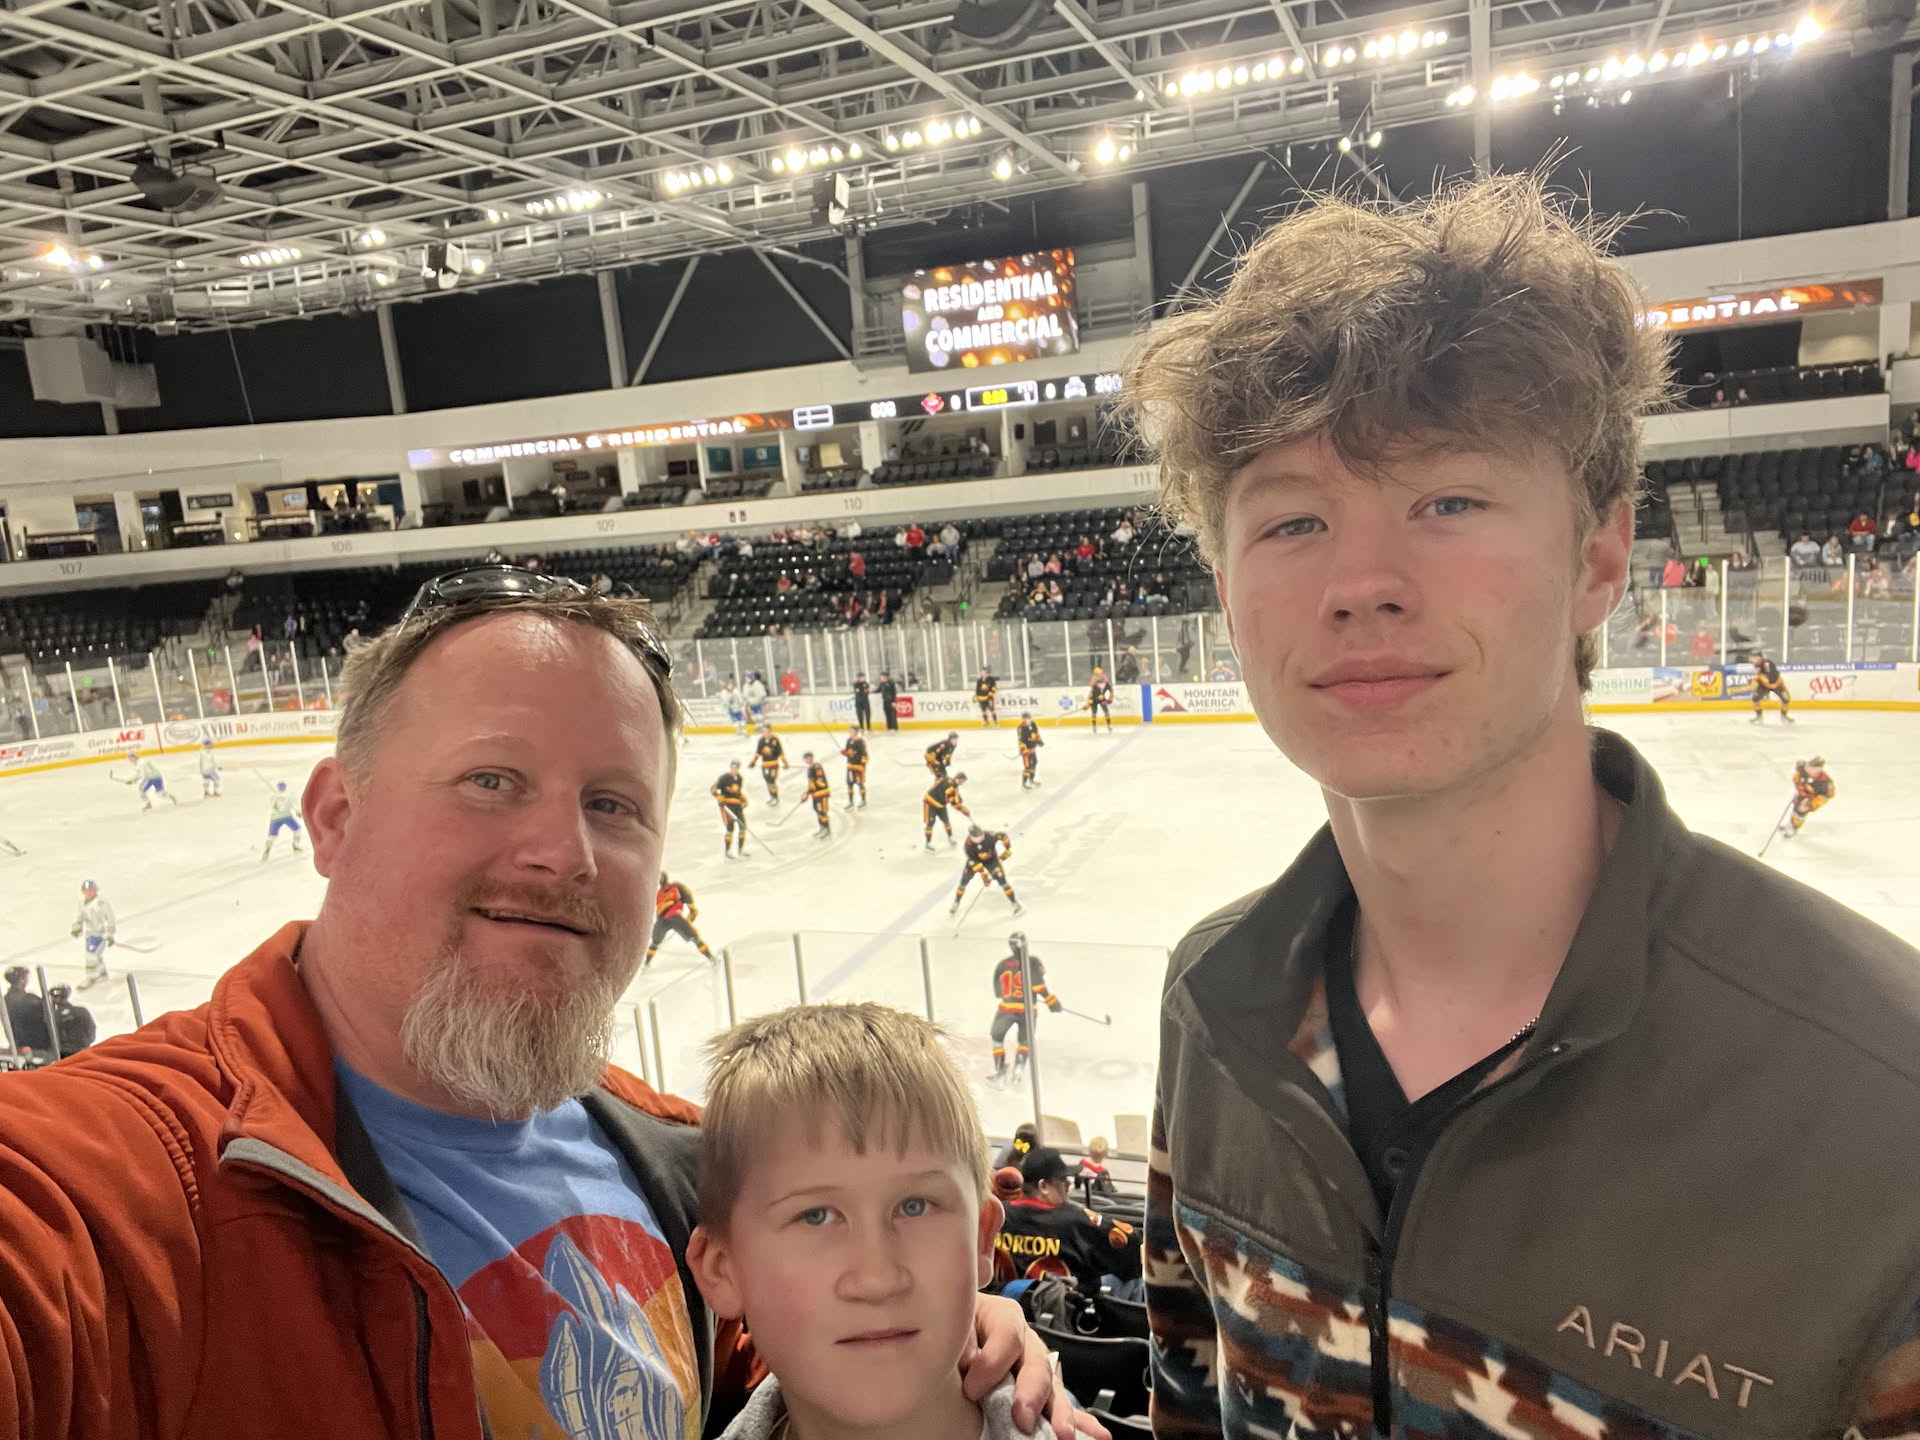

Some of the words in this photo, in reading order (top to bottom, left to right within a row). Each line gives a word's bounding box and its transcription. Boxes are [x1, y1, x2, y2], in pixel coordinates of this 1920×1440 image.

[924, 271, 1058, 312] RESIDENTIAL
[978, 305, 1004, 321] AND
[925, 314, 1063, 352] COMMERCIAL
[450, 438, 582, 463] COMMERCIAL
[586, 435, 602, 449] &
[608, 420, 746, 446] RESIDENTIAL
[844, 497, 862, 511] 110
[597, 519, 616, 532] 109
[331, 541, 353, 553] 108
[59, 562, 83, 575] 107
[1184, 688, 1239, 699] MOUNTAIN
[918, 700, 970, 712] TOYOTA
[1188, 698, 1236, 707] AMERICA
[116, 730, 145, 743] ACE
[1557, 1305, 1774, 1408] ARIAT
